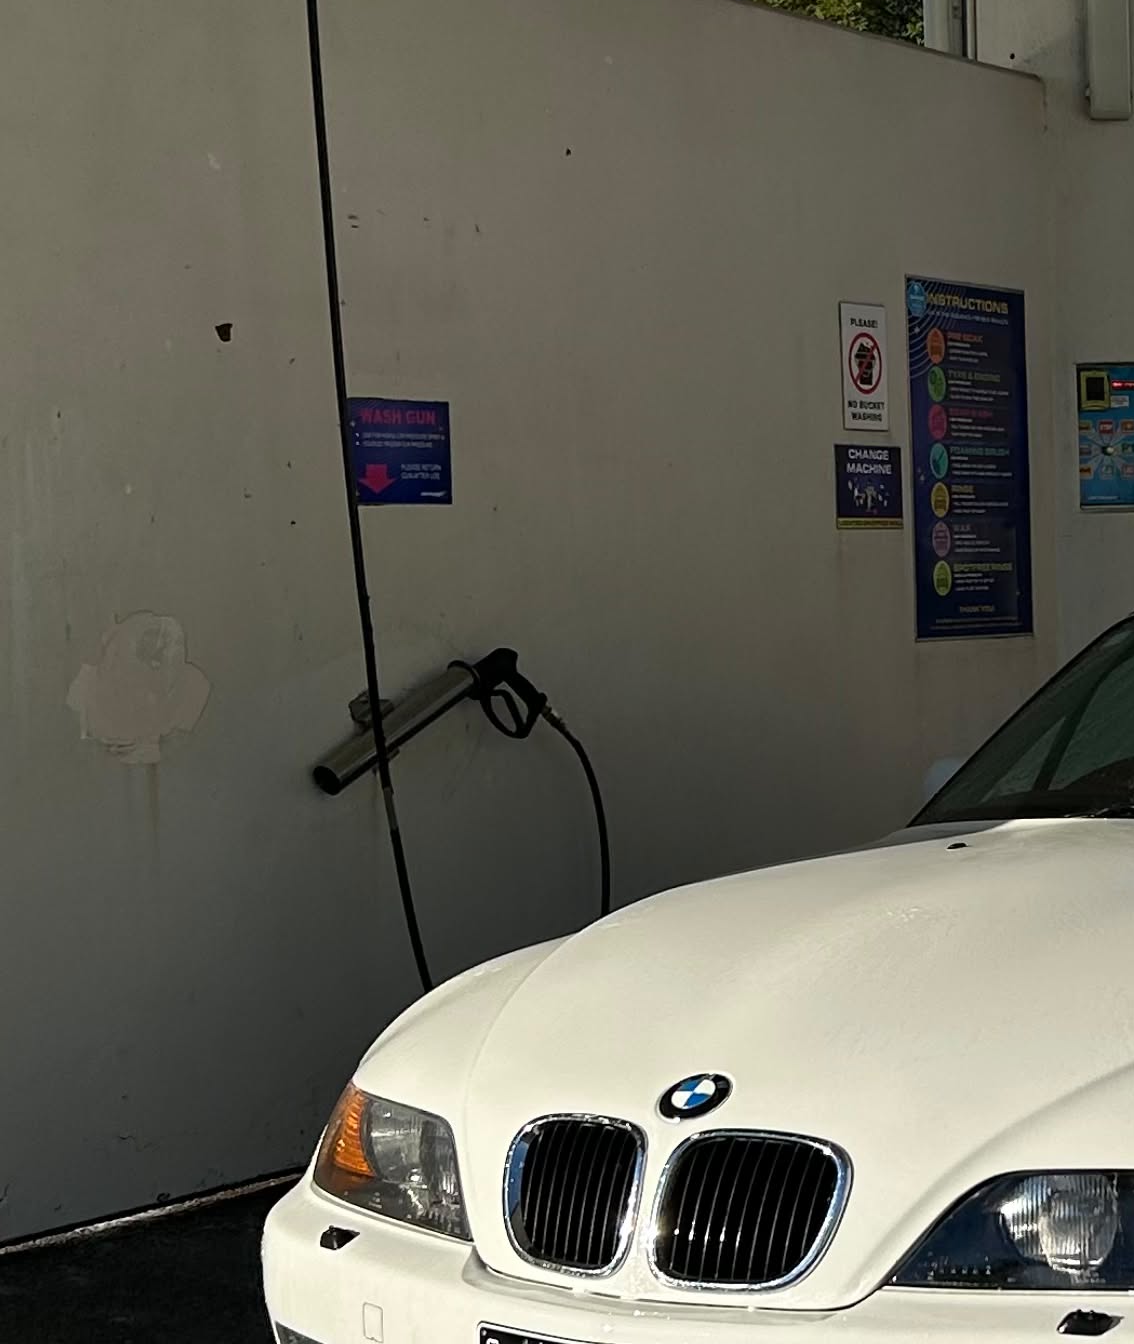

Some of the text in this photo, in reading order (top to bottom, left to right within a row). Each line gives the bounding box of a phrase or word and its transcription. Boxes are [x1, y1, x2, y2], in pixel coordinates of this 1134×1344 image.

[927, 293, 1008, 315] INSTRUCTIONS
[850, 318, 878, 328] PLEASE!
[848, 400, 885, 411] NO BUCKET
[360, 408, 437, 425] WASH GUN
[851, 412, 882, 422] WASHING
[848, 448, 889, 461] CHANGE
[846, 462, 893, 475] MACHINE
